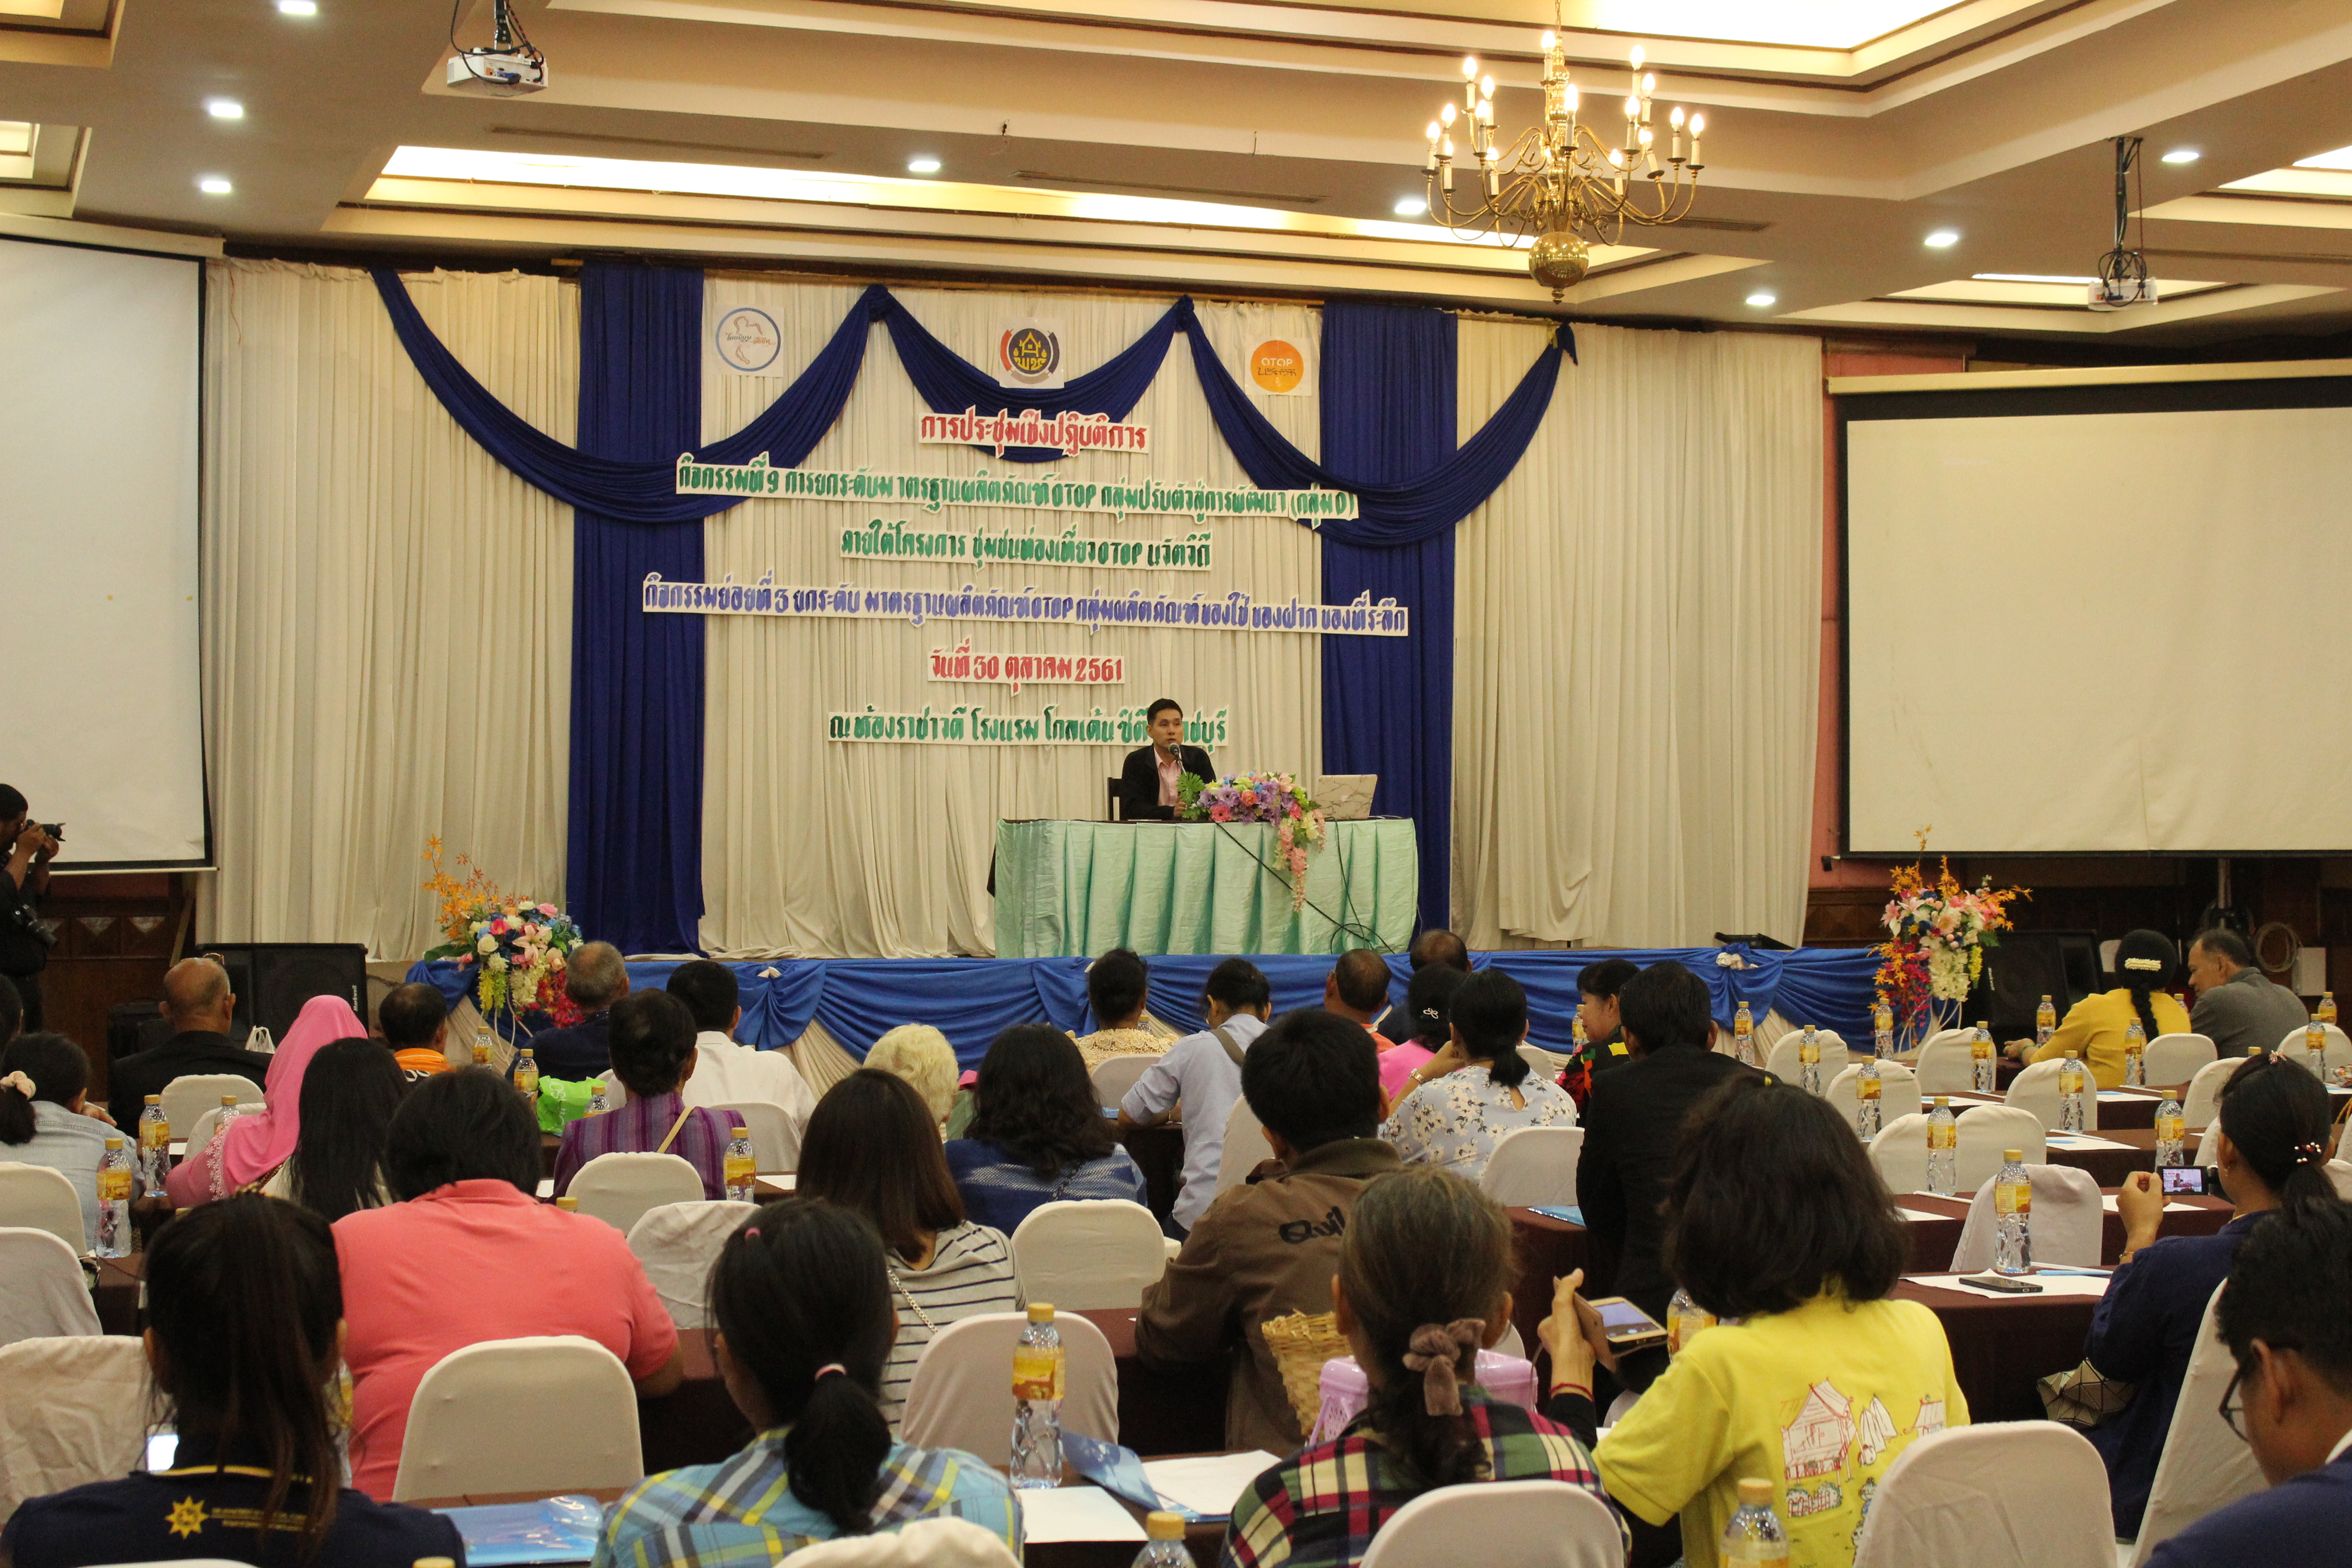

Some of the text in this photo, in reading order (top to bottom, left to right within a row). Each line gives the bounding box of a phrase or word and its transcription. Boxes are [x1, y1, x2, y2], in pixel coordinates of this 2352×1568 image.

[1261, 358, 1293, 367] OTOP
[921, 407, 1147, 455] การประชุมเชิงปฏิบัติการ
[1005, 656, 1072, 693] ตุลาคม
[1076, 657, 1122, 682] 2561
